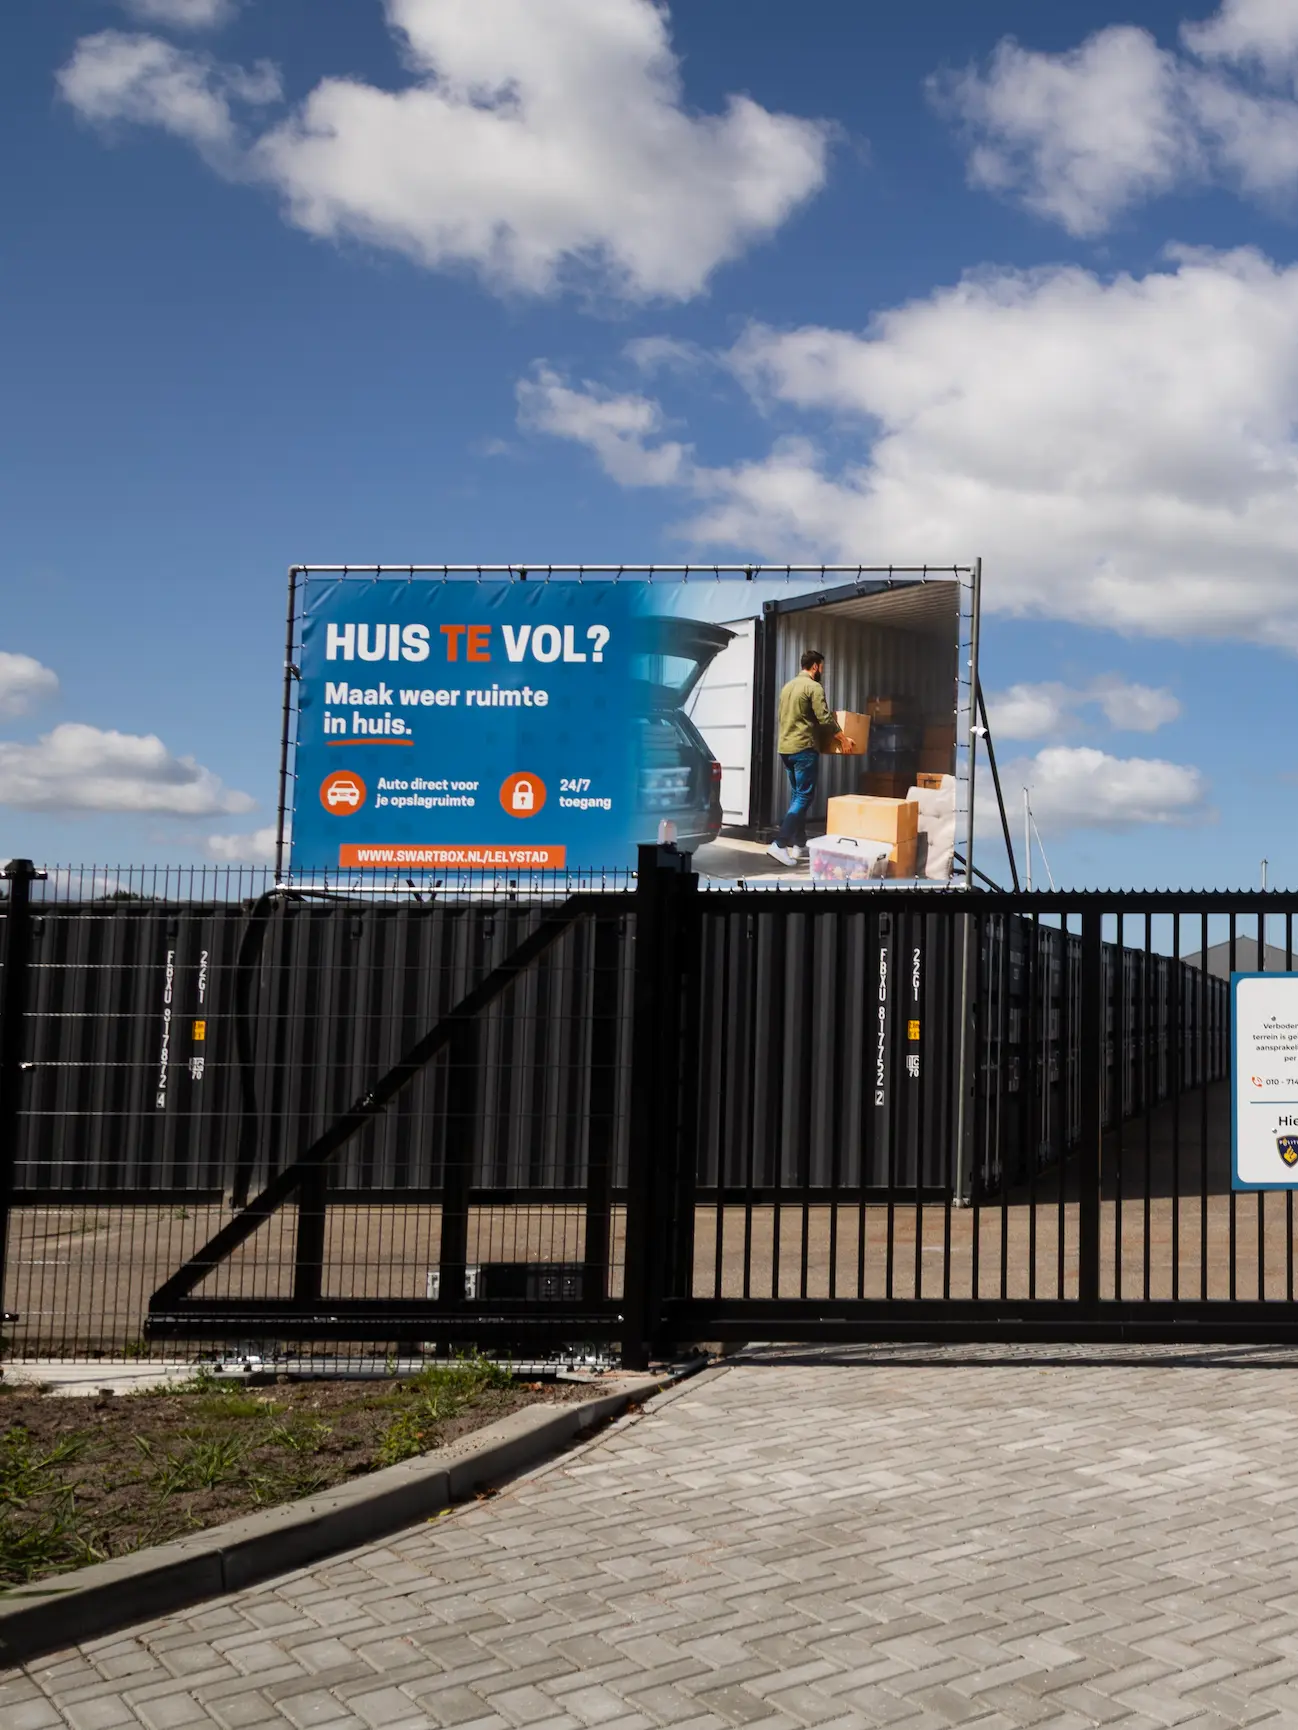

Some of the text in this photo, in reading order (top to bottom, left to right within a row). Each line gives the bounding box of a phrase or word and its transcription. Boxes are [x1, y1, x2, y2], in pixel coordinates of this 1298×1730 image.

[326, 623, 611, 662] HUIS TE VOL?
[325, 682, 549, 706] Maak weer ruimte
[324, 711, 412, 735] in huis.
[377, 778, 479, 791] Auto direct voor
[560, 778, 591, 792] 24/7
[375, 794, 475, 809] je opslagruimte
[559, 796, 612, 810] toegang
[357, 849, 549, 863] WWW.SWARTBOX.NL/LELYSTAD
[912, 948, 921, 1001] 22G1
[876, 948, 888, 1105] FBXU 817752 2
[1252, 1033, 1279, 1041] terrein
[908, 1069, 919, 1078] 70
[1265, 1078, 1280, 1086] 010
